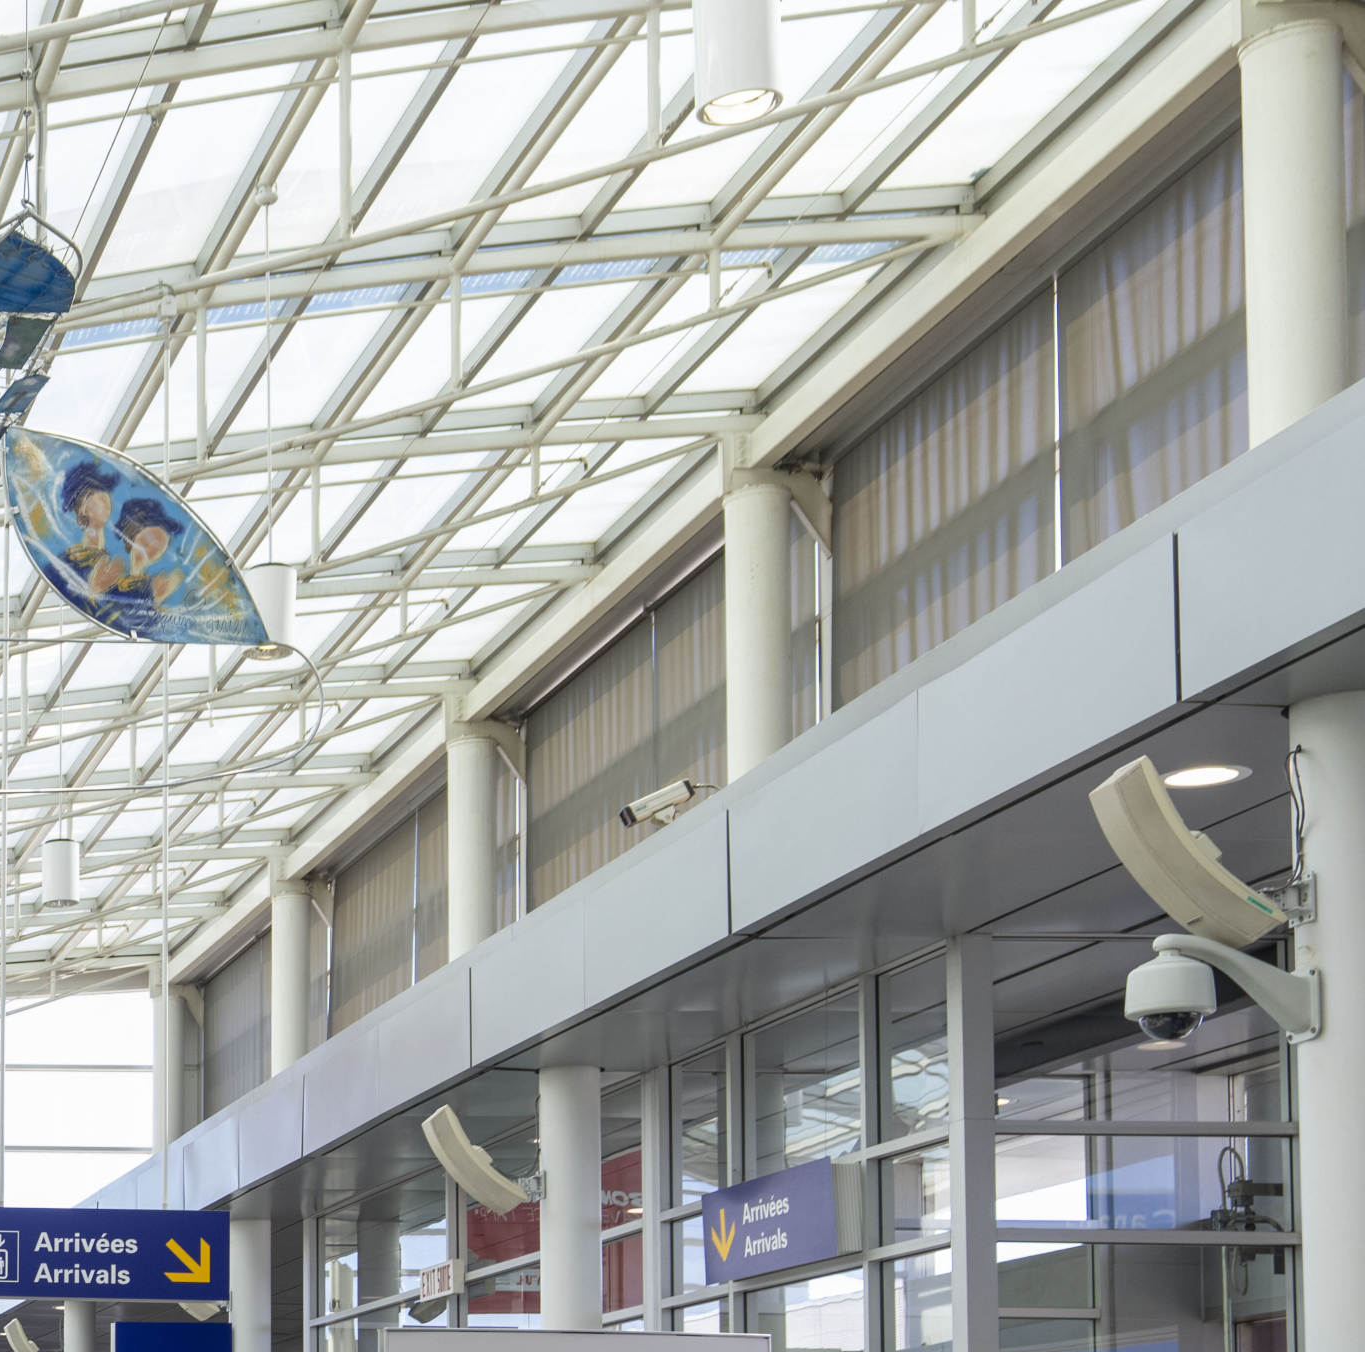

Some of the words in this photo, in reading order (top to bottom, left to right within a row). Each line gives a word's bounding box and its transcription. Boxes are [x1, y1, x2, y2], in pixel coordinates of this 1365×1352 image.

[742, 1193, 789, 1225] Arrivées
[34, 1232, 137, 1253] Arrivées
[743, 1227, 788, 1258] Arrivals
[34, 1263, 130, 1284] Arrivals
